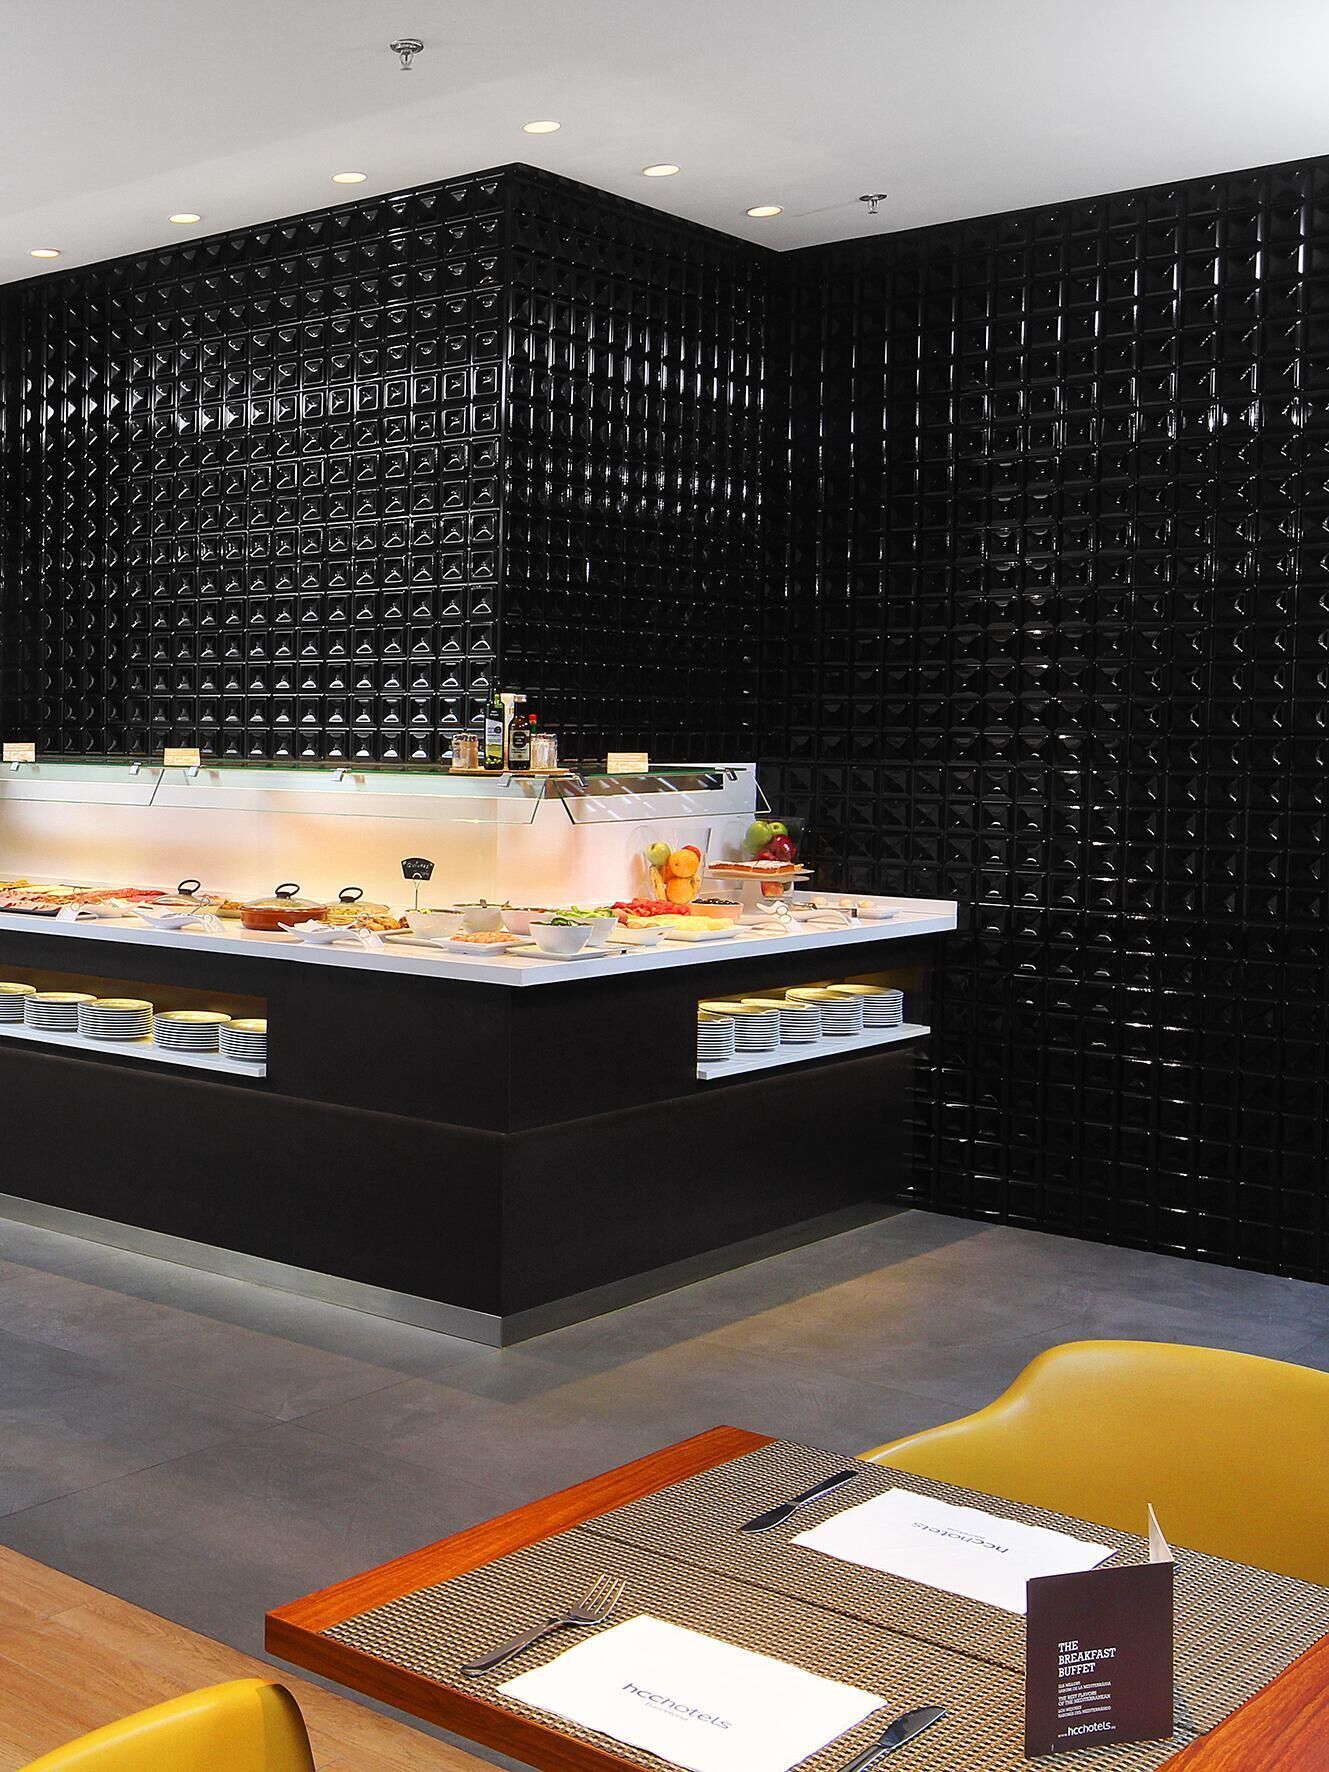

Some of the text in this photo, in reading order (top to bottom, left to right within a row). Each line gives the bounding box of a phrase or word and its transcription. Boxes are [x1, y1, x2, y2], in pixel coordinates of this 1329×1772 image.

[1058, 1640, 1079, 1653] THE
[1058, 1647, 1116, 1665] BREAKFAST
[1058, 1662, 1096, 1678] BUFFET
[622, 1683, 732, 1729] hcchotels
